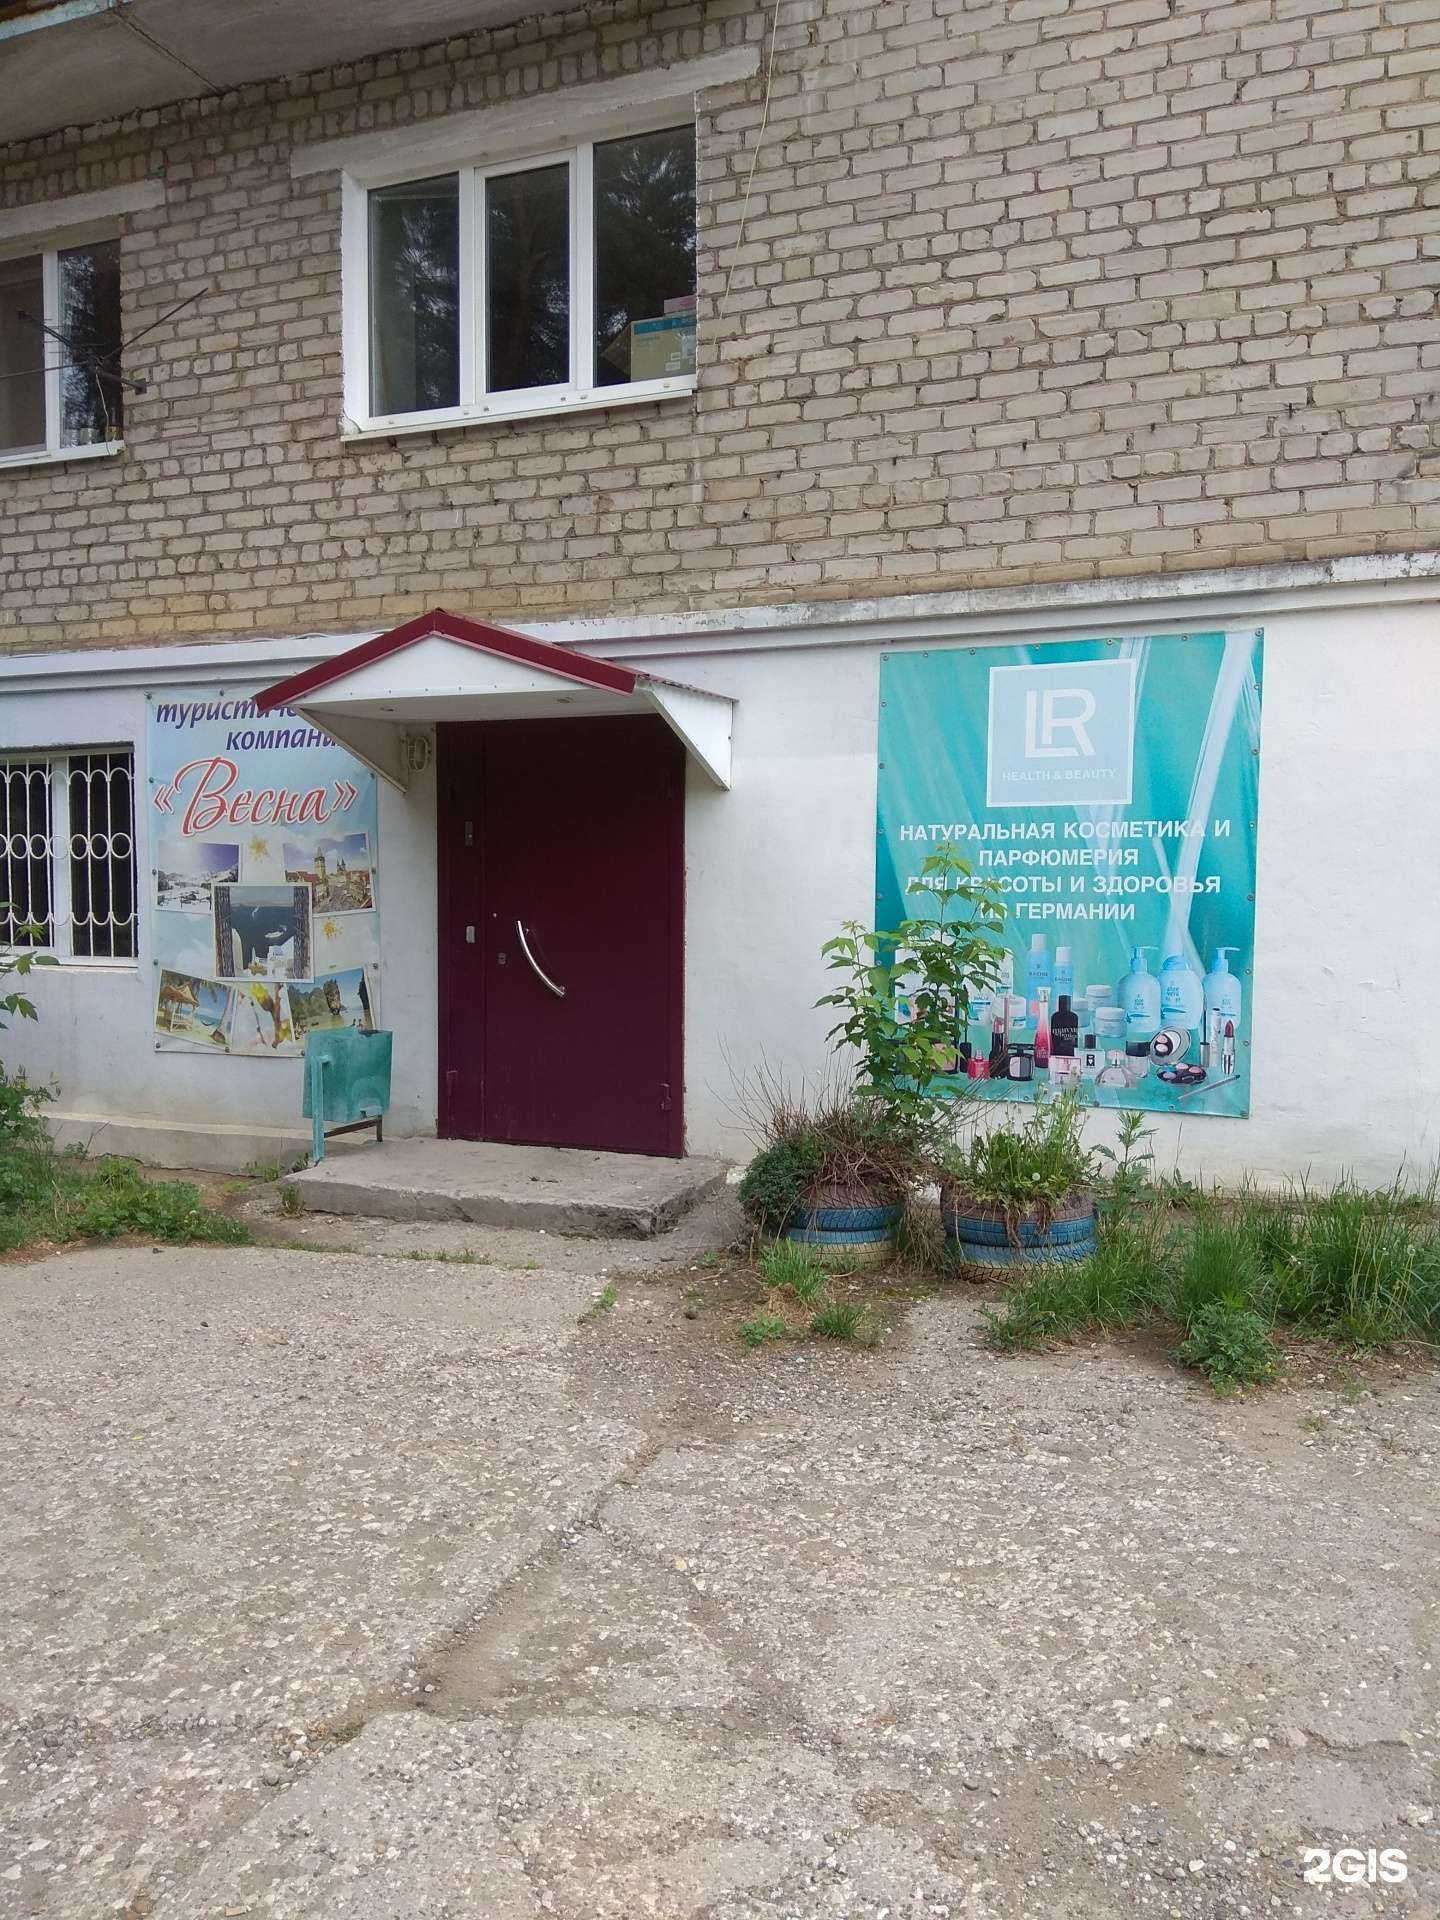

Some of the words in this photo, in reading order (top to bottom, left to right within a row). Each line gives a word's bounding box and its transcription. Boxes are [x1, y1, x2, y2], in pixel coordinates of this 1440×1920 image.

[1025, 688, 1096, 758] LR
[226, 726, 341, 751] компани
[1002, 769, 1050, 782] HEALTH
[1052, 770, 1062, 781] &
[1064, 768, 1116, 780] BEAUTY
[899, 822, 1056, 841] НАТУРАЛЬНАЯ
[1064, 819, 1205, 840] КОСМЕТИКА
[1214, 819, 1231, 838] И
[978, 848, 1139, 867] ПАРФЮМЕРИЯ
[1070, 875, 1086, 893] И
[1092, 874, 1221, 897] ЗДОРОВЬЯ
[1016, 902, 1136, 921] ГЕРМАНИИ
